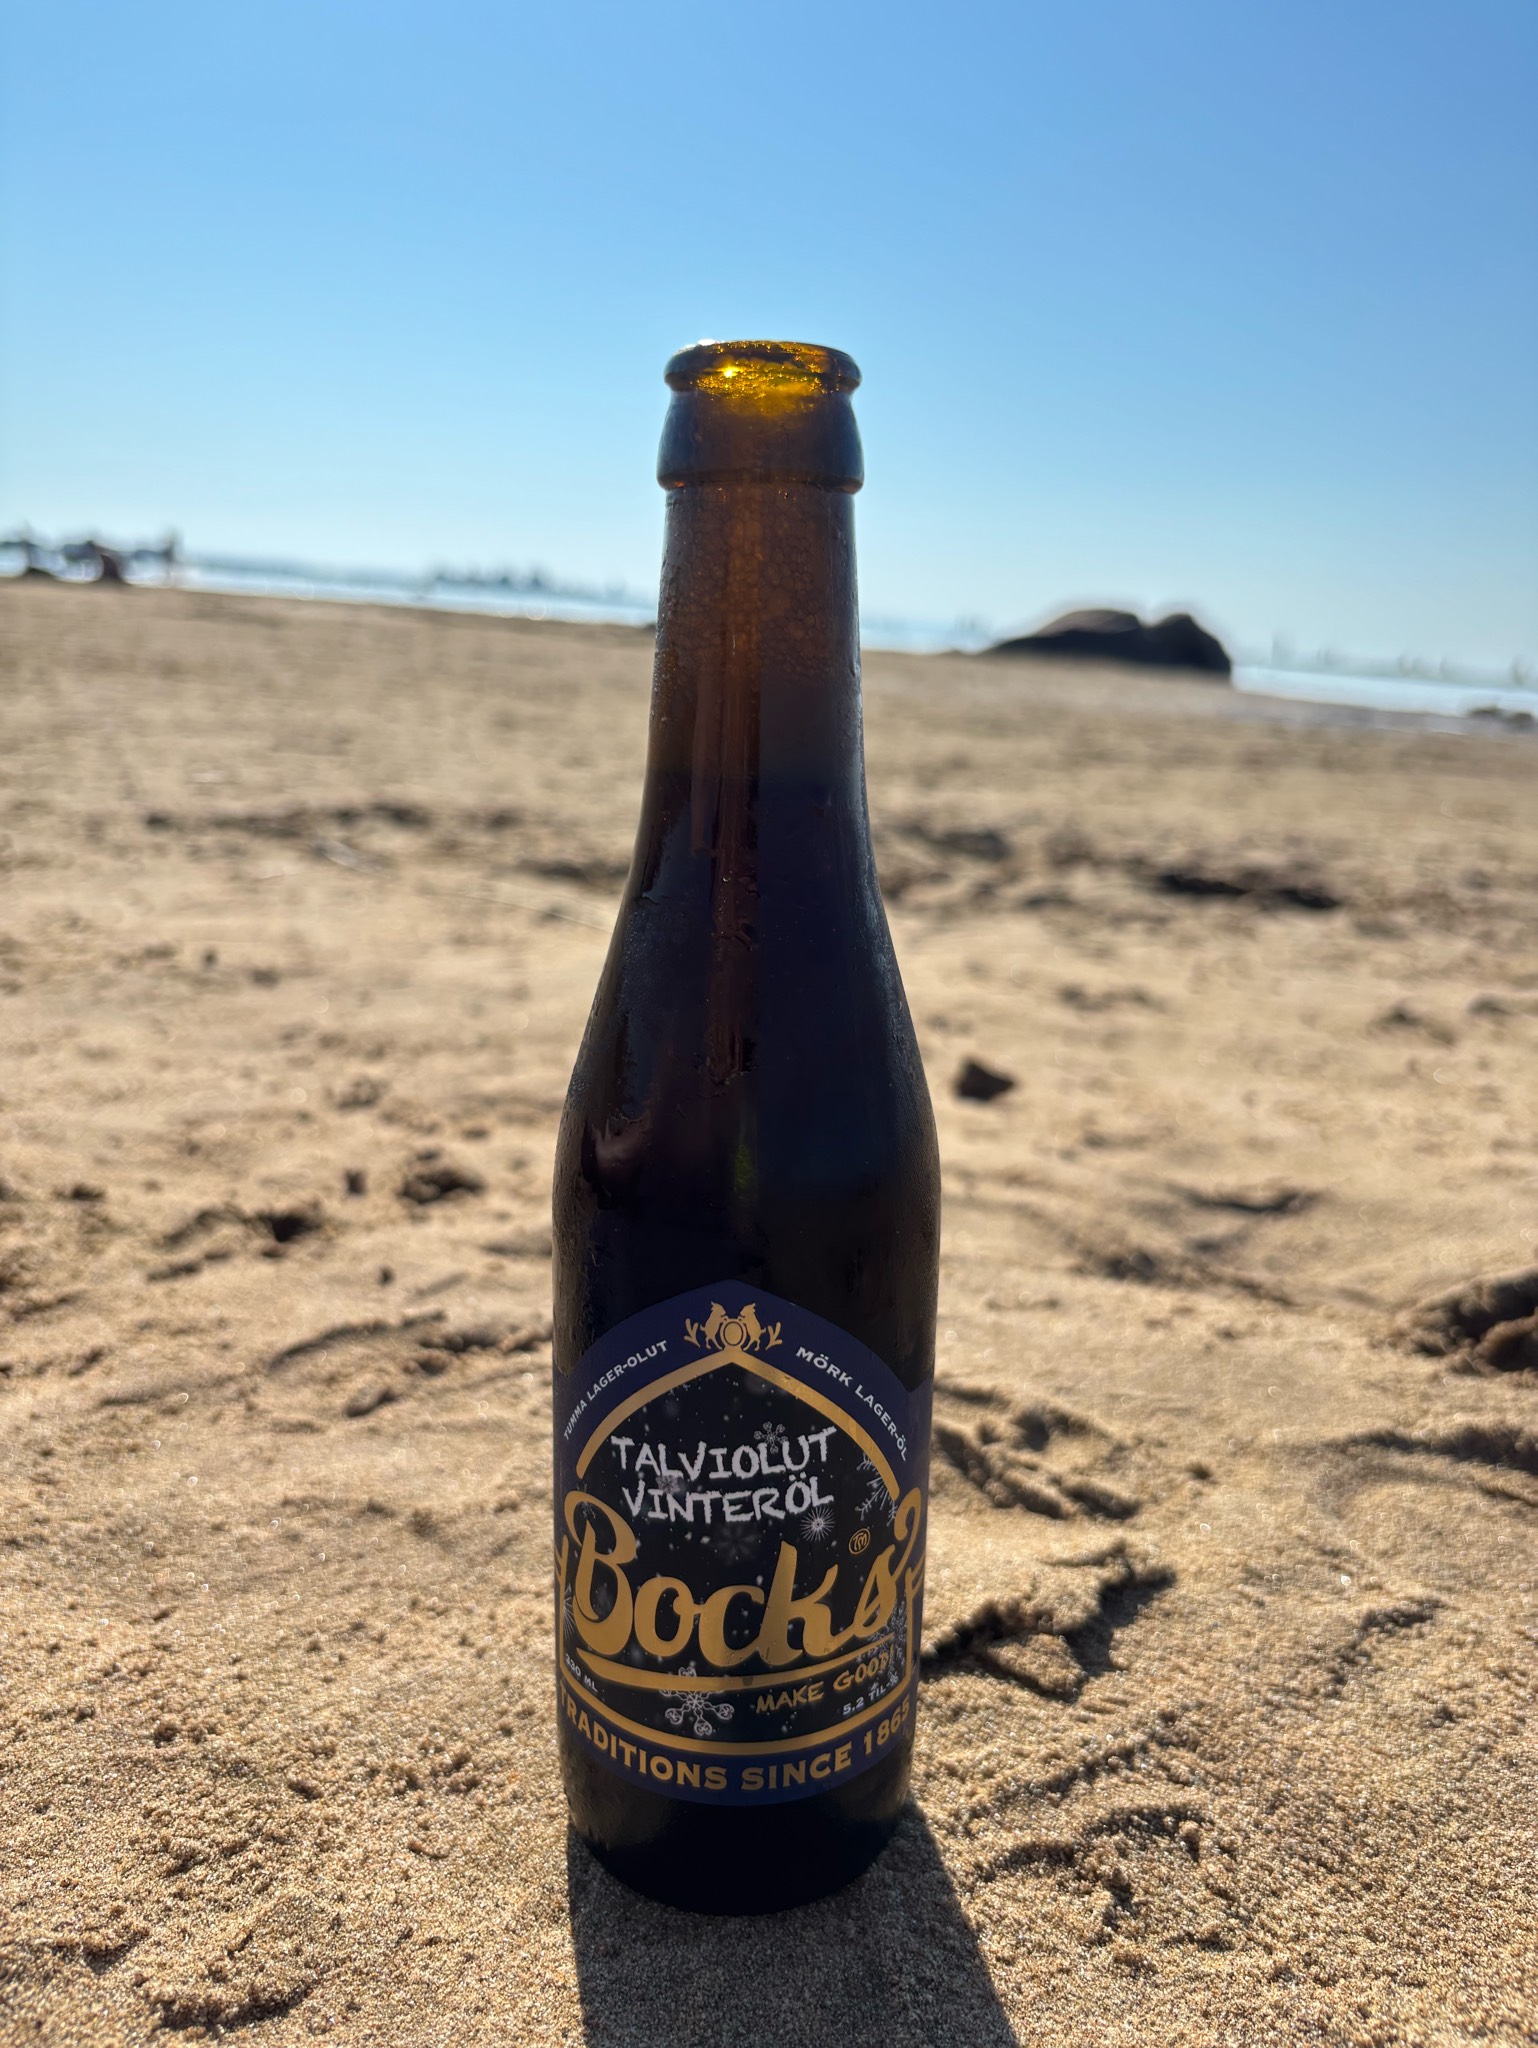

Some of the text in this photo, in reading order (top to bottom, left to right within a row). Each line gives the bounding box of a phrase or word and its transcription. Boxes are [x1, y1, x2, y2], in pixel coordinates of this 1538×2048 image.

[563, 1340, 668, 1441] TUMMA LAGER-OLUT
[795, 1346, 909, 1462] MÖRK LAGER-ÖL
[610, 1426, 838, 1482] TALVIOLUT
[622, 1471, 835, 1525] VINTERÖL
[565, 1653, 599, 1693] 330 ML
[756, 1680, 825, 1714] MAKE
[842, 1696, 866, 1716] 5,2
[559, 1679, 910, 1791] TRADITIONS SINCE 1865
